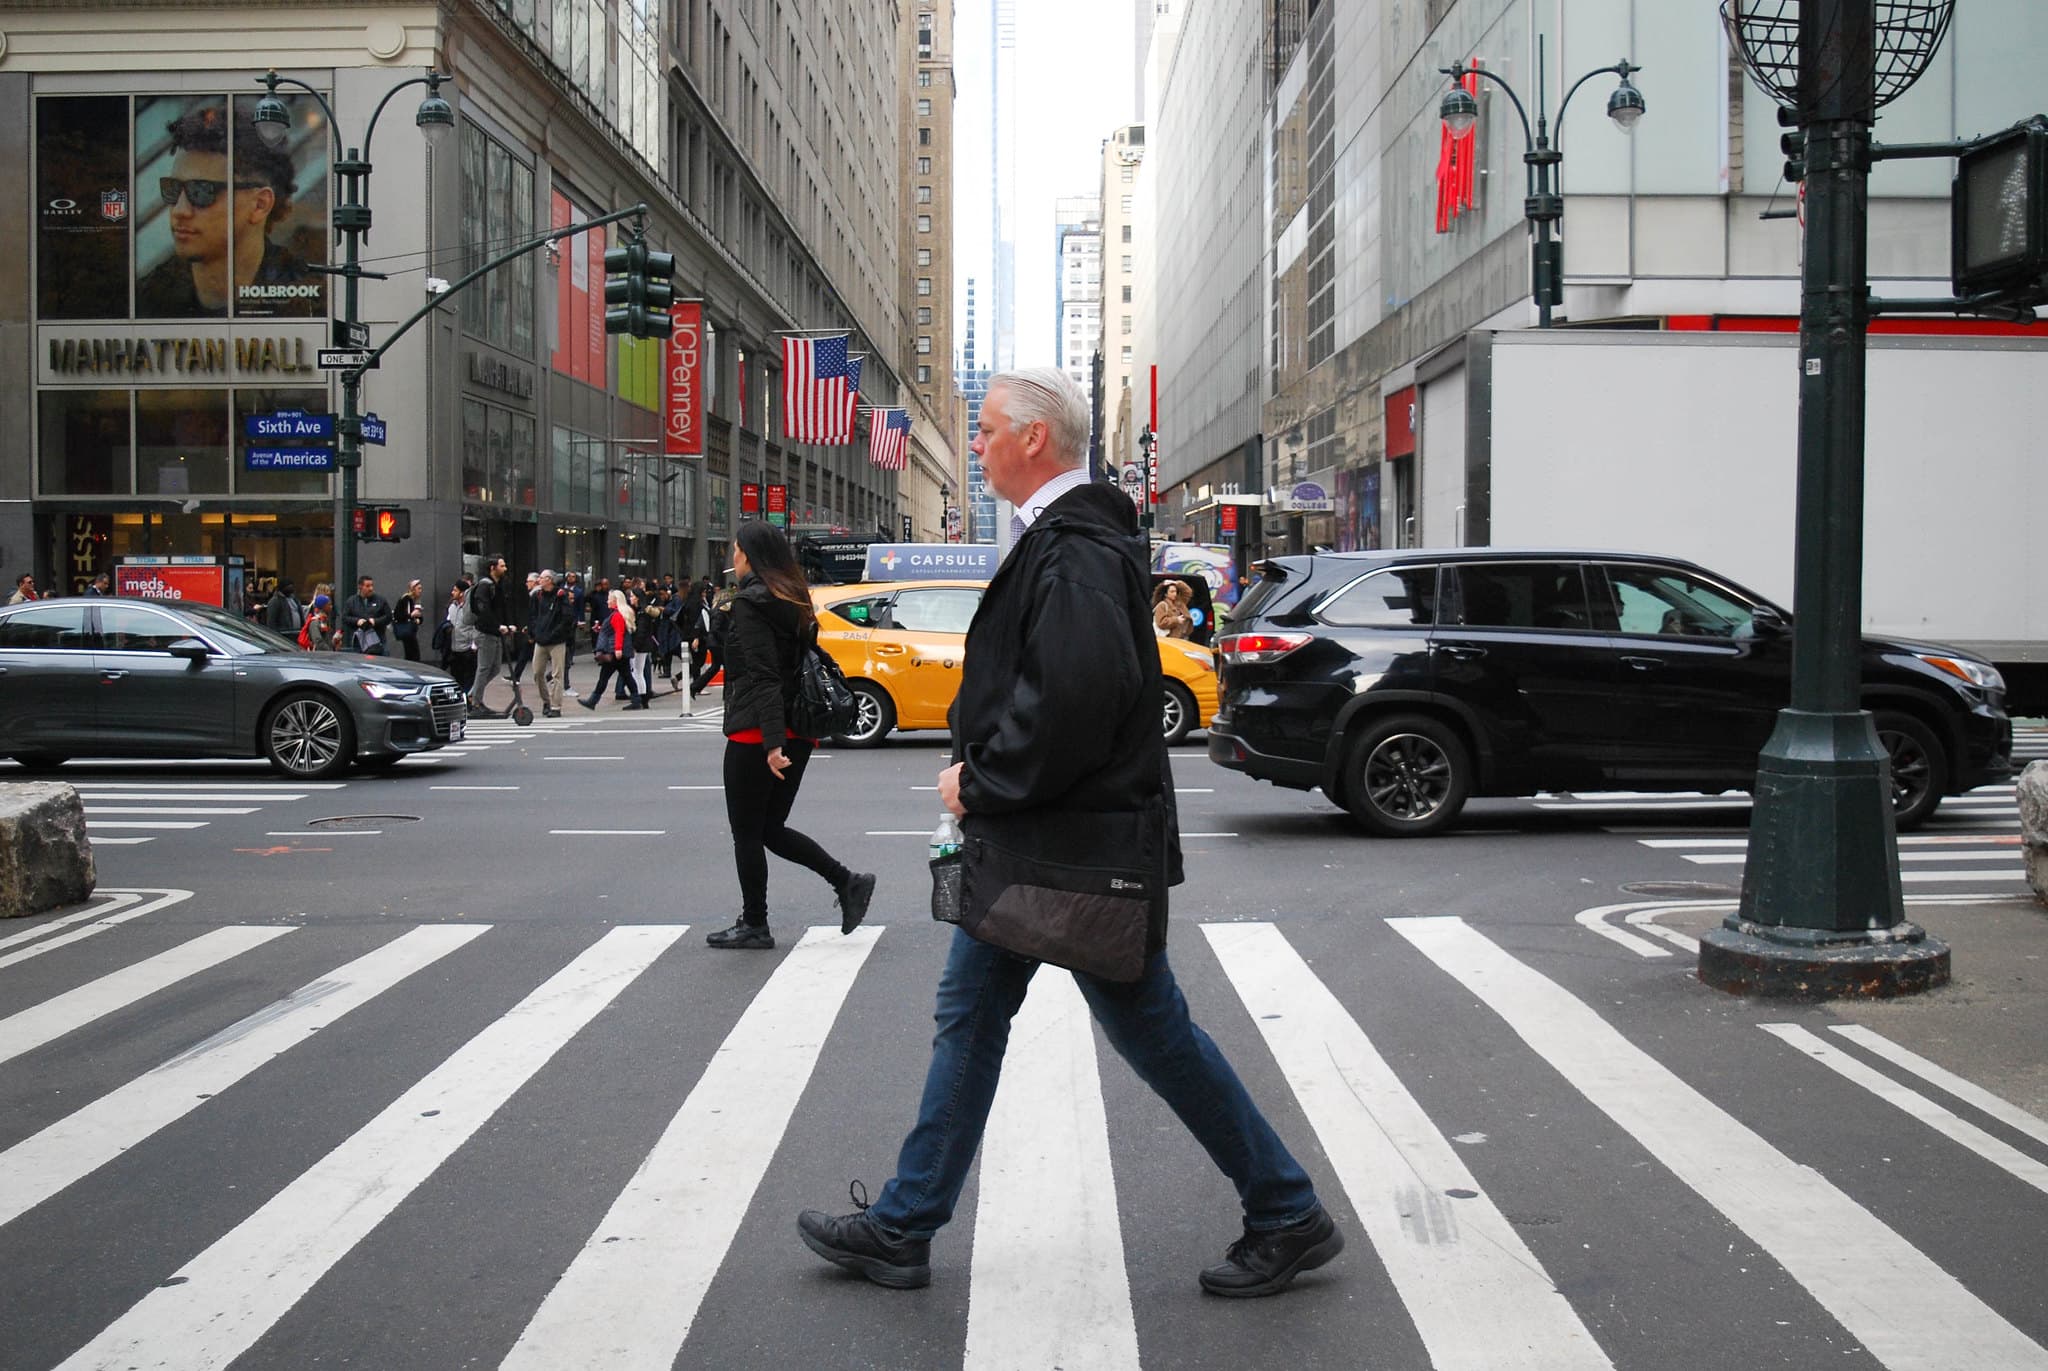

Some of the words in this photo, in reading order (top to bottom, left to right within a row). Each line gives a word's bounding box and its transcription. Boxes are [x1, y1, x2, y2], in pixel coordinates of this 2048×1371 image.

[104, 203, 125, 216] NFL
[239, 285, 320, 298] HOLBROOK
[50, 338, 226, 372] MANHATTAN
[235, 337, 312, 372] MALL
[326, 355, 344, 364] ONE
[667, 313, 697, 443] JCPenney
[258, 420, 292, 434] Sixth
[295, 420, 321, 434] Ave
[273, 452, 328, 465] Americas
[1220, 482, 1239, 495] 111
[910, 554, 987, 566] CAPSULE
[125, 576, 165, 591] meds
[142, 587, 182, 600] made
